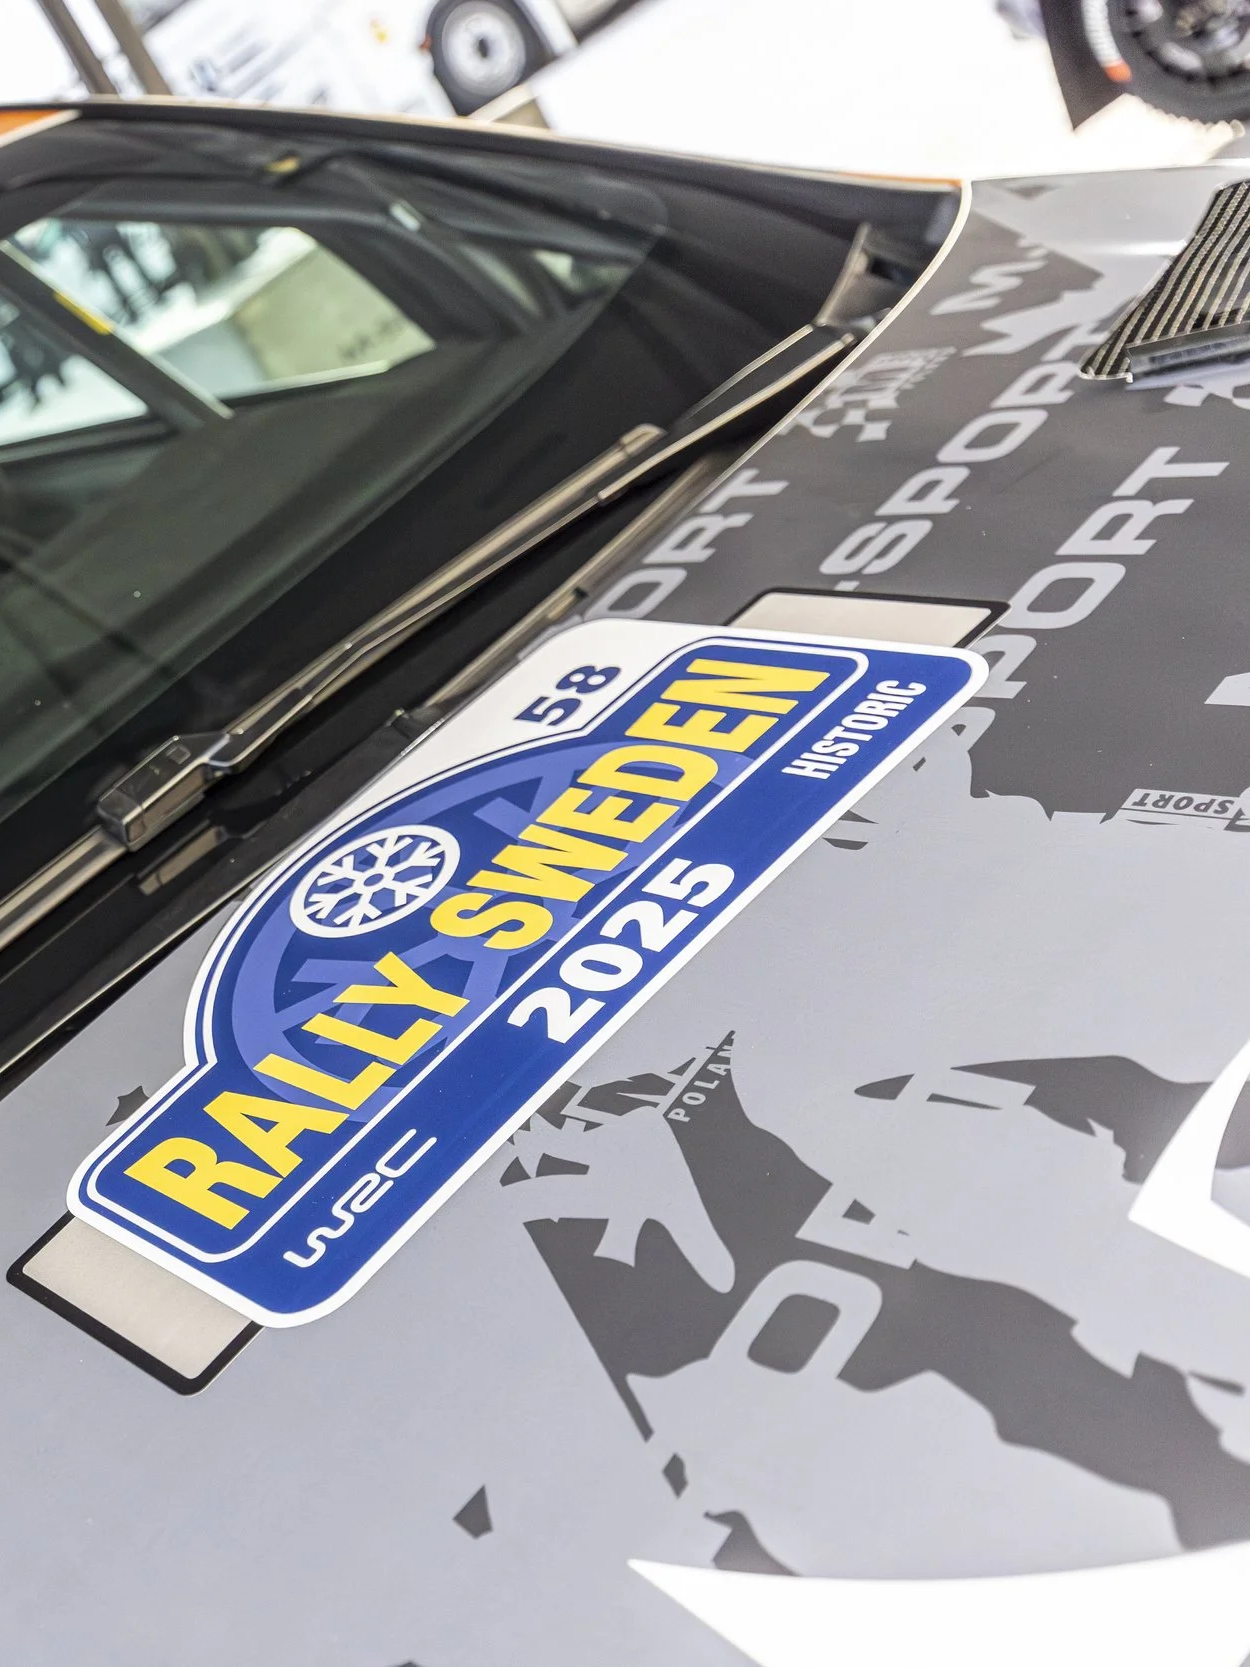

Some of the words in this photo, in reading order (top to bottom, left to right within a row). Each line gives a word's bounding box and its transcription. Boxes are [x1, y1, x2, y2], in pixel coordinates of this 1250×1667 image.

[513, 664, 622, 727] 58
[782, 679, 927, 779] HISTORIC
[123, 953, 470, 1230] RALLY
[431, 657, 831, 950] SWEDEN
[507, 858, 735, 1045] 2025
[283, 1128, 438, 1268] WRC
